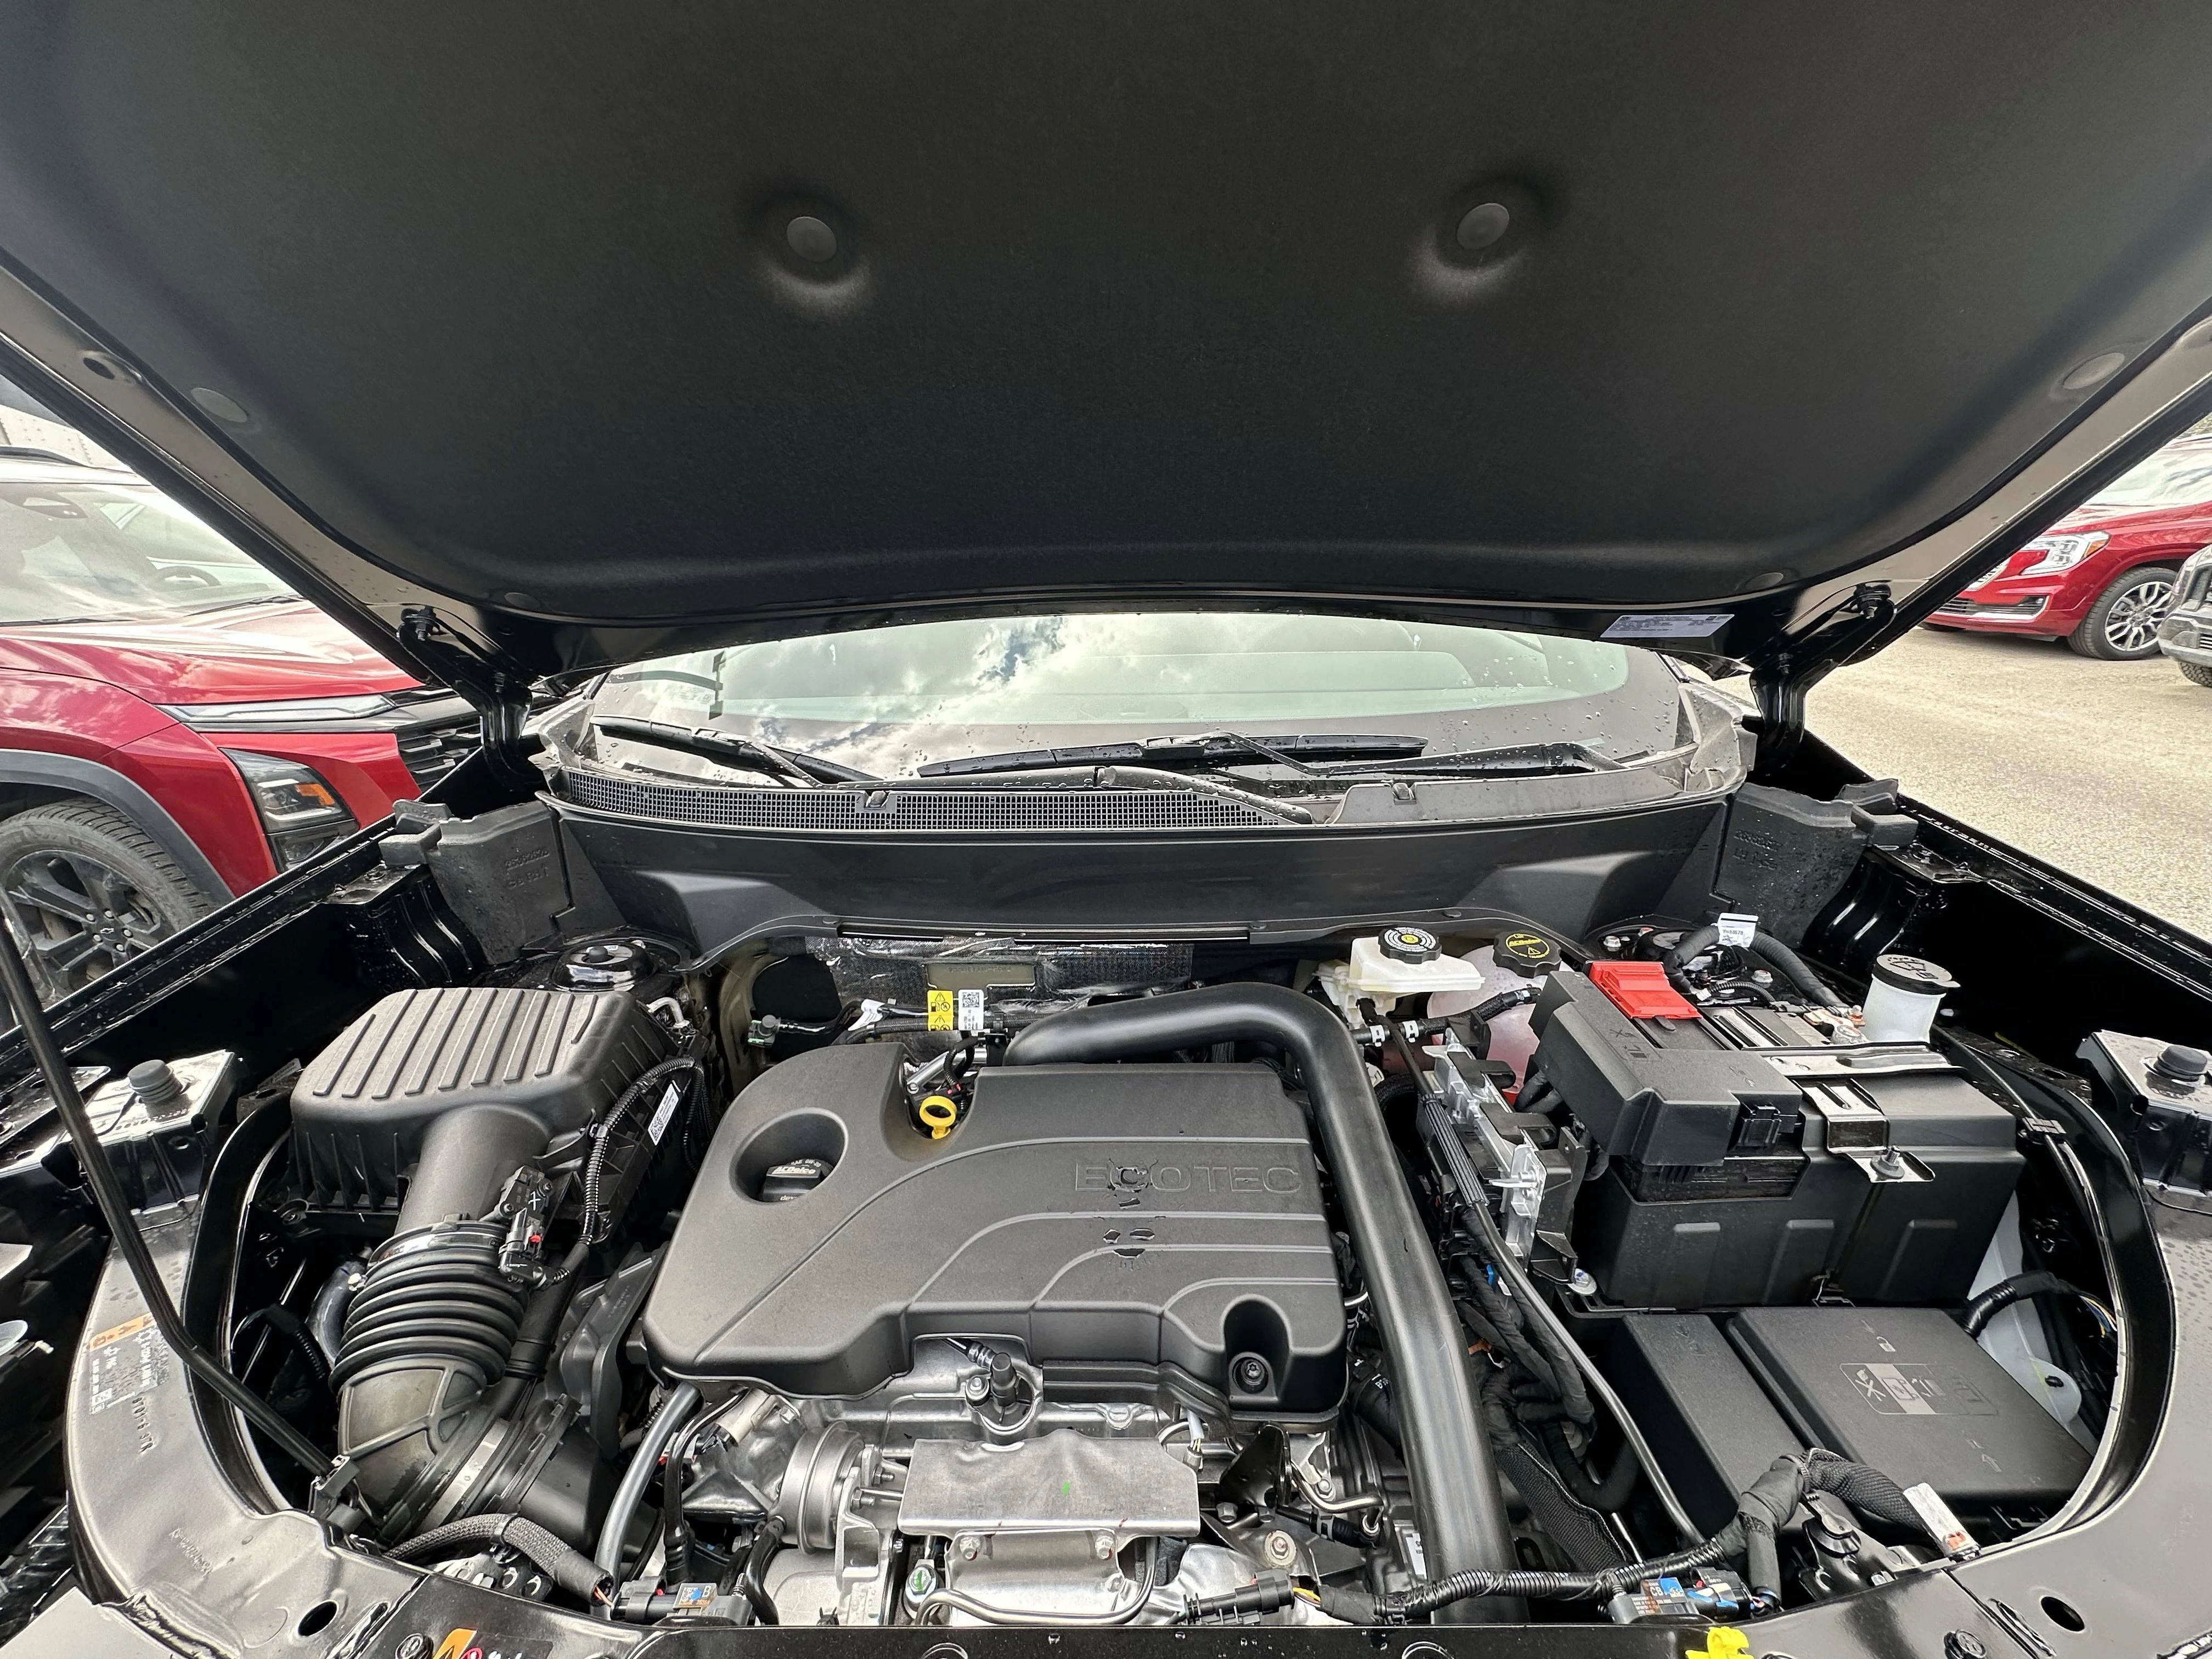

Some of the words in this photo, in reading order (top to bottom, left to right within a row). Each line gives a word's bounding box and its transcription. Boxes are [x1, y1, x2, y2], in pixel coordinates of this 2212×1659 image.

[771, 1166, 816, 1175] ACDelco
[1075, 1163, 1302, 1194] ECOTEC
[702, 1585, 712, 1598] B
[1650, 1586, 1664, 1596] CB
